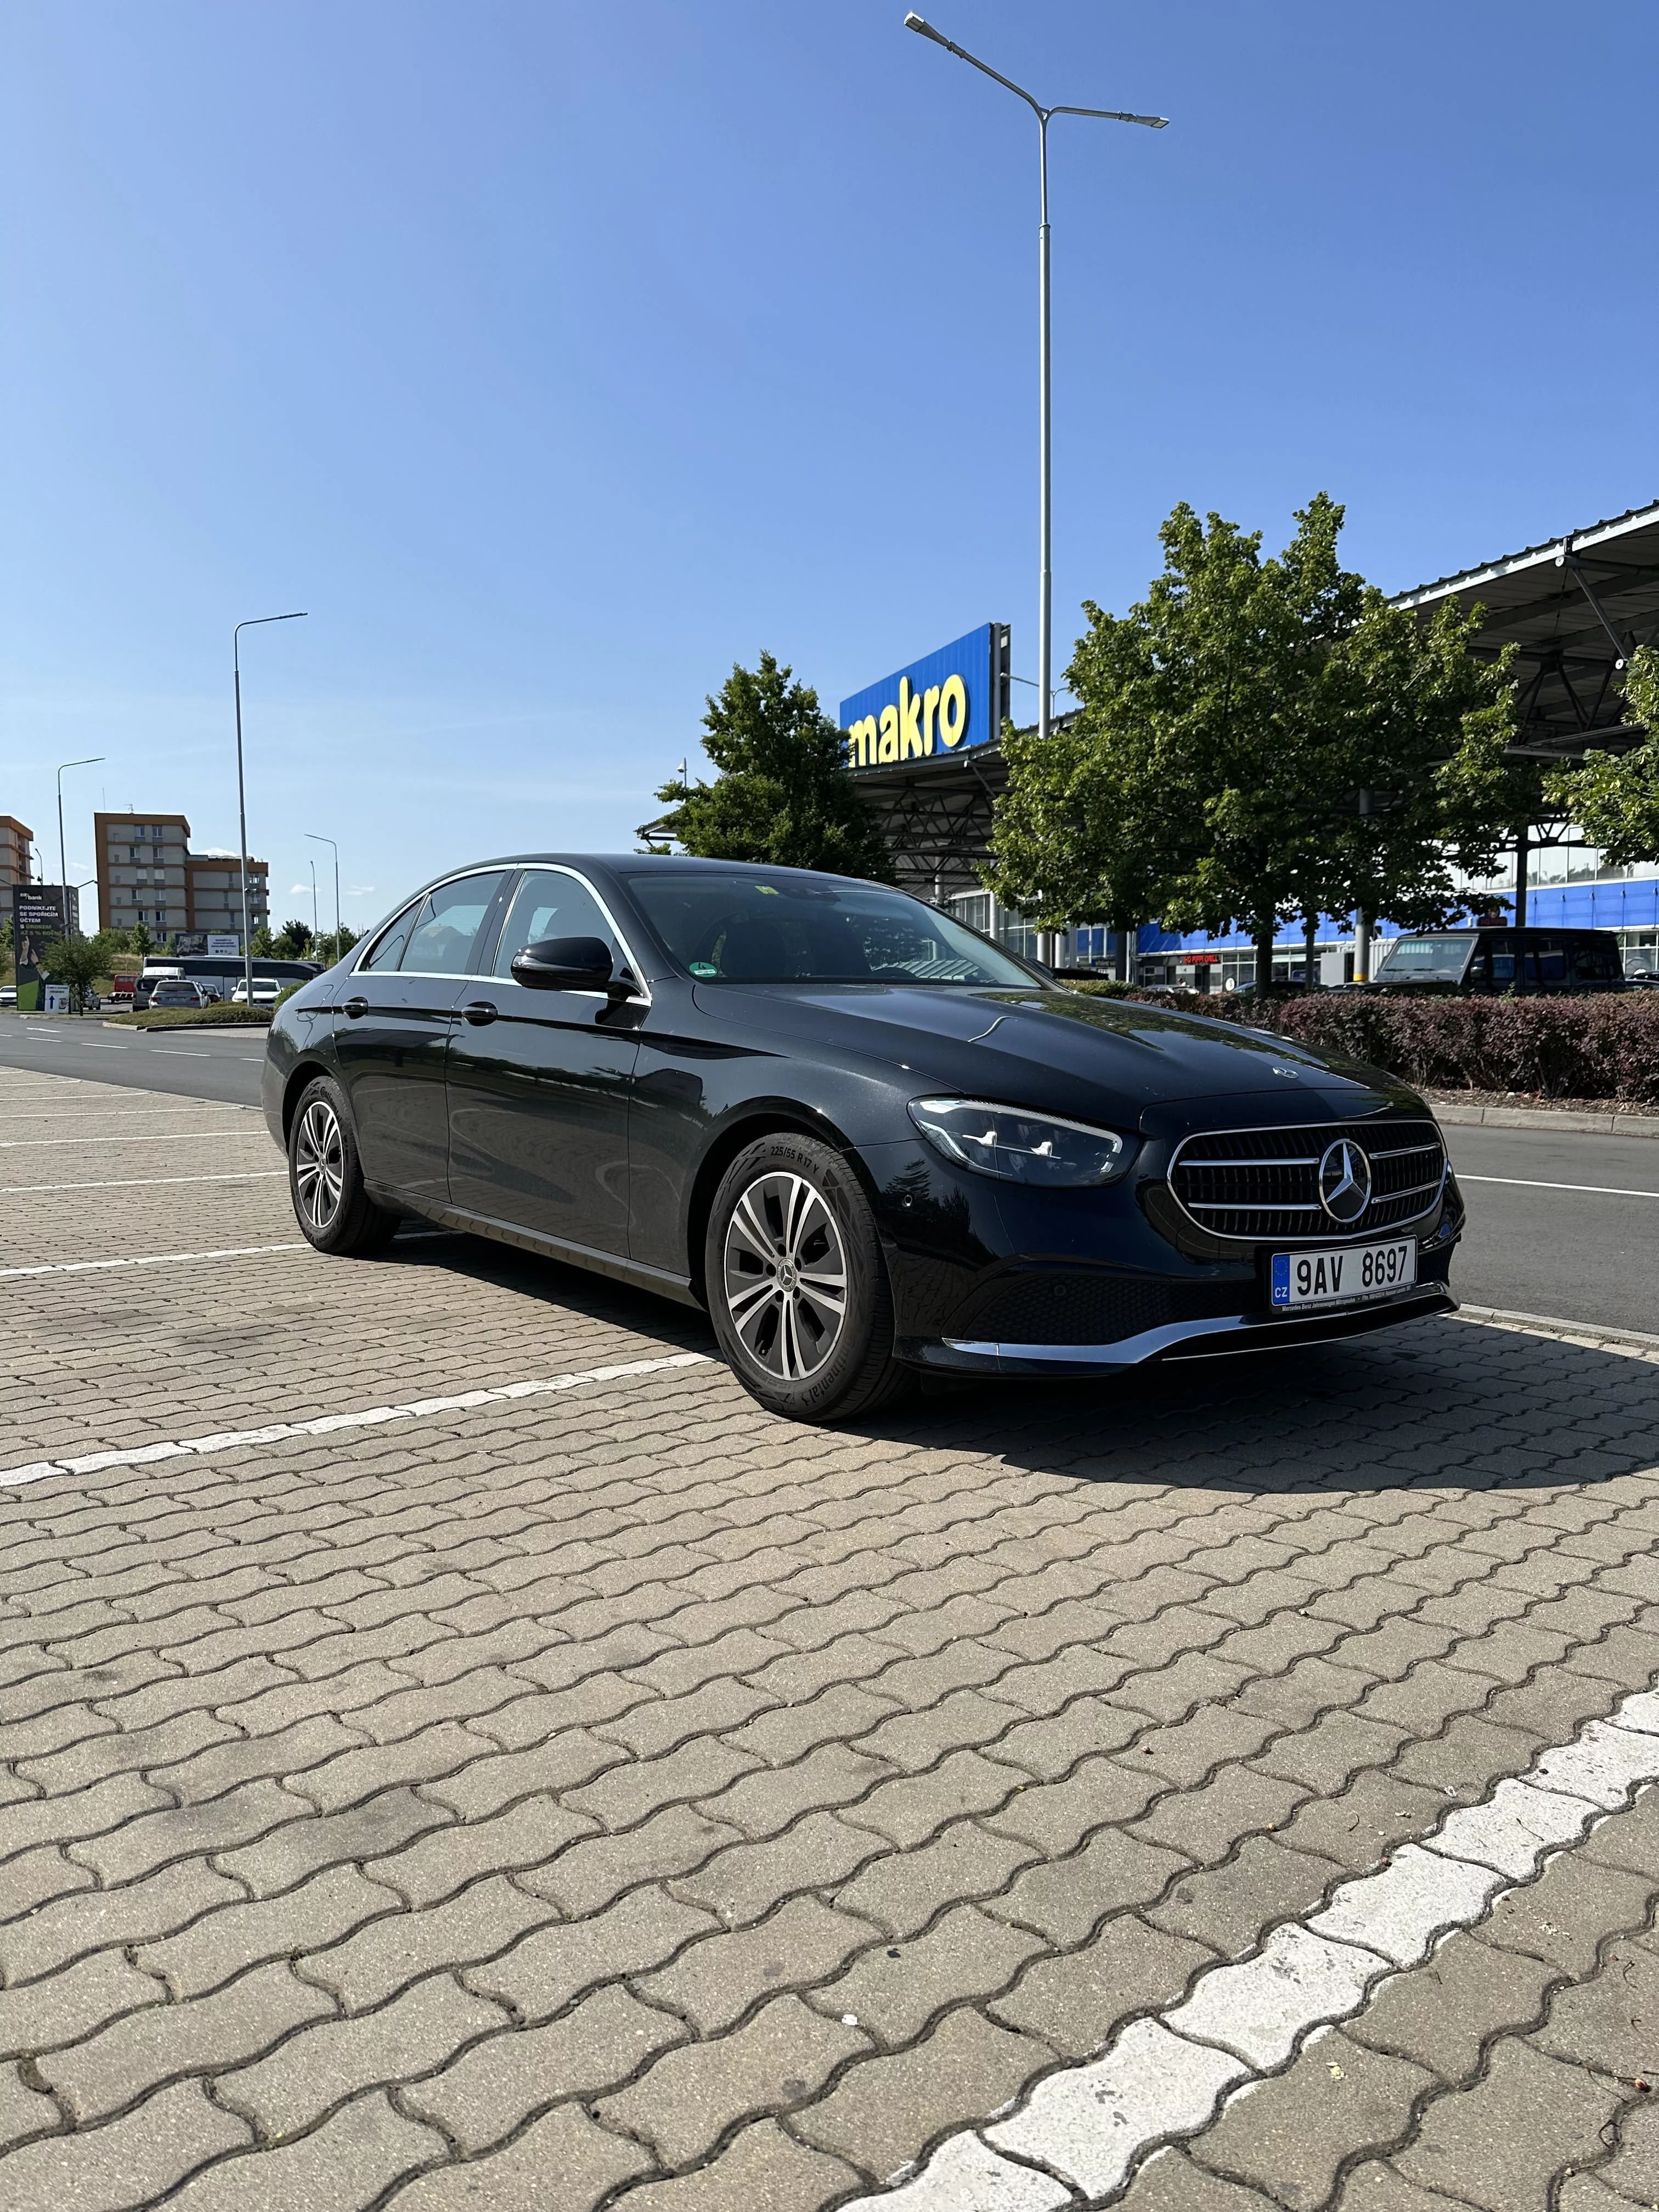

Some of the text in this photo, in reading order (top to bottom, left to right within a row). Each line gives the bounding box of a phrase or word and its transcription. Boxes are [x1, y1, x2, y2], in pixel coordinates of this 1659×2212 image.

[849, 674, 966, 768] makro
[771, 1146, 820, 1174] 225/55 R 17 Y
[1296, 1245, 1408, 1296] 9AV 8697
[1274, 1286, 1288, 1299] CZ
